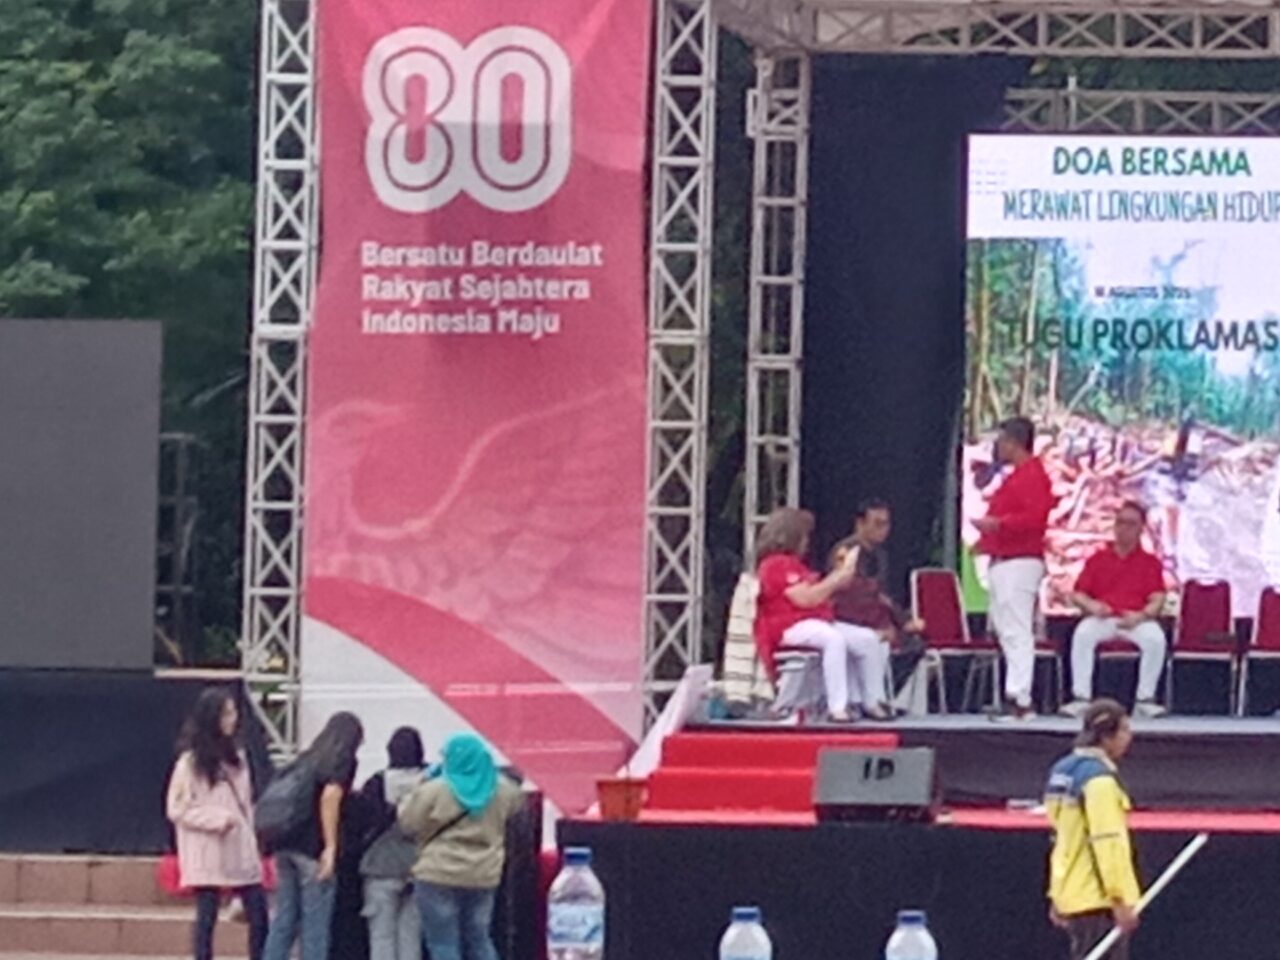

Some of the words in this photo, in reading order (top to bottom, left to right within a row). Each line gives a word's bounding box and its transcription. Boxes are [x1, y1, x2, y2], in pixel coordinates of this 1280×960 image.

[362, 25, 572, 212] 80
[1053, 146, 1113, 176] DOA
[1121, 147, 1253, 177] BERSAMA
[1002, 189, 1093, 222] MERAWAT
[1097, 190, 1218, 223] LINGKUNGAN
[361, 241, 465, 267] Bersatu
[471, 241, 603, 267] Berdaulat
[361, 275, 453, 306] Rakyat
[459, 273, 591, 306] Sejahtera
[361, 310, 491, 335] Indonesia
[497, 309, 561, 340] Maju
